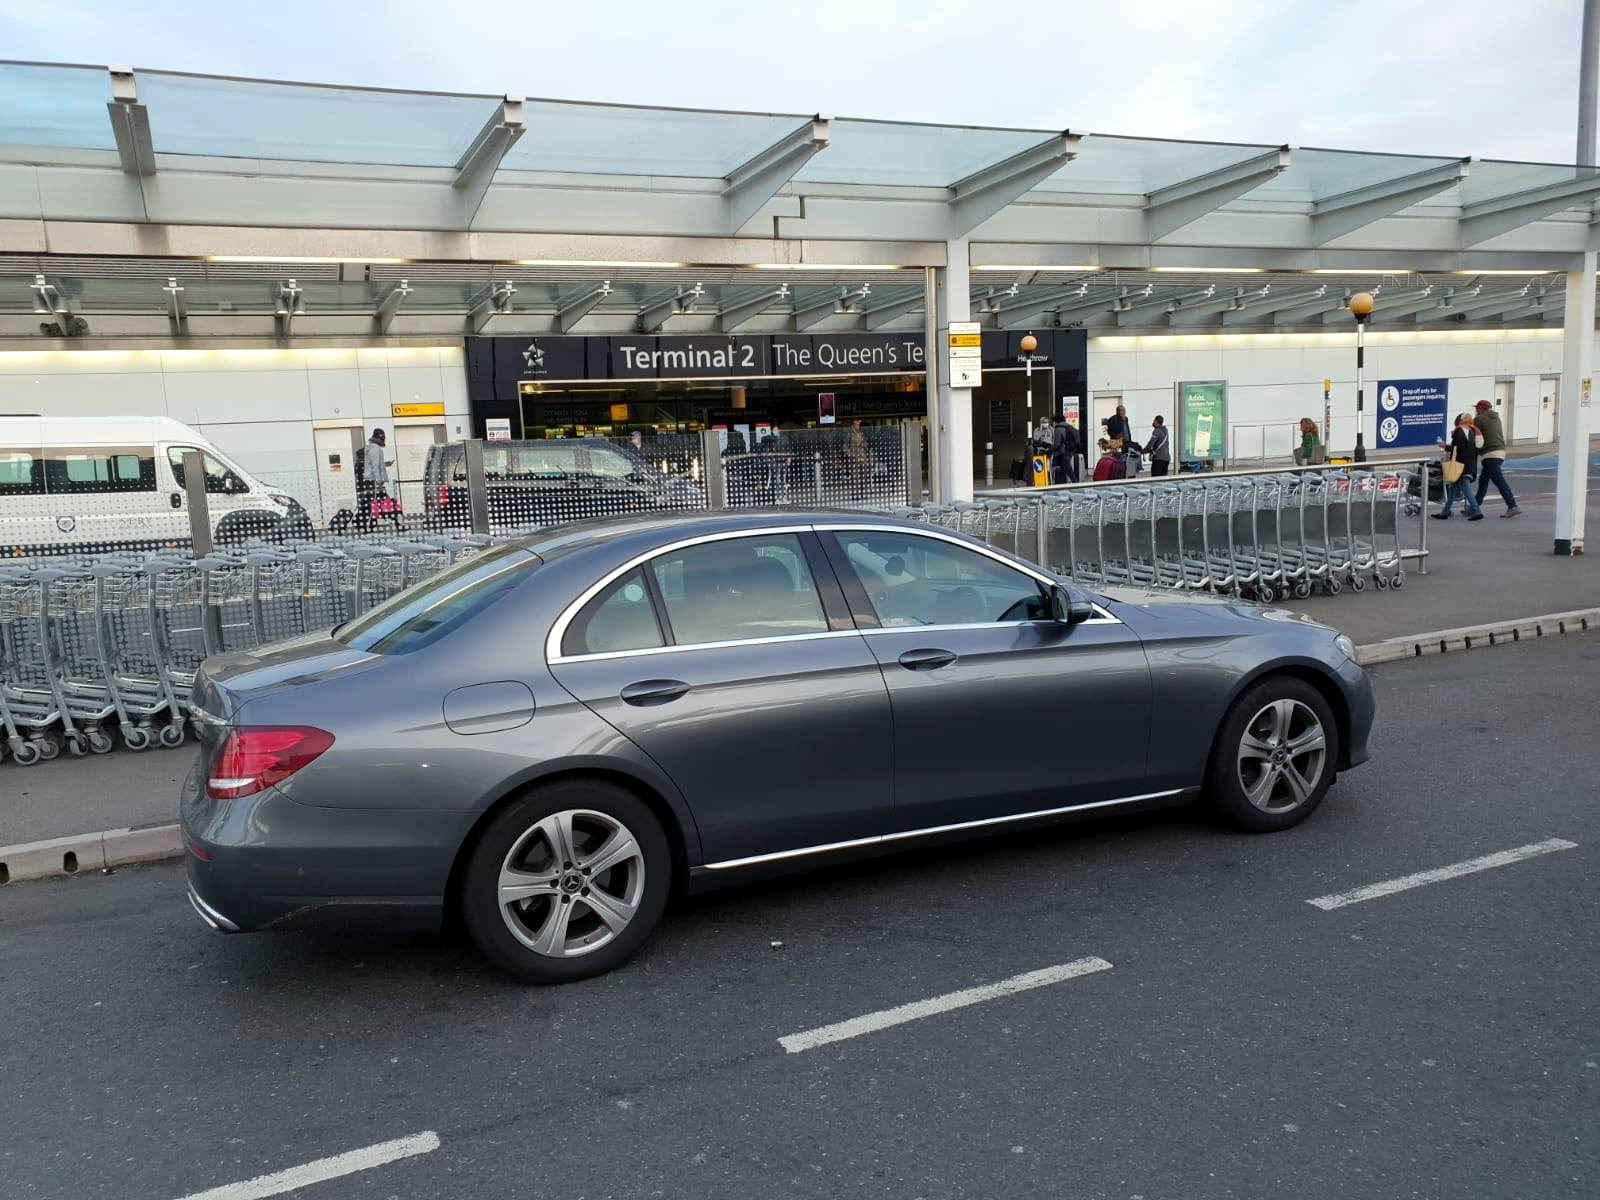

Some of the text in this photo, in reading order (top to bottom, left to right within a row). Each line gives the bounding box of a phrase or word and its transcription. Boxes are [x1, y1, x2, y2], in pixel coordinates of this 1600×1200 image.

[620, 342, 926, 369] Terminal 2 The Queen's Te
[1017, 354, 1049, 363] Hethrow
